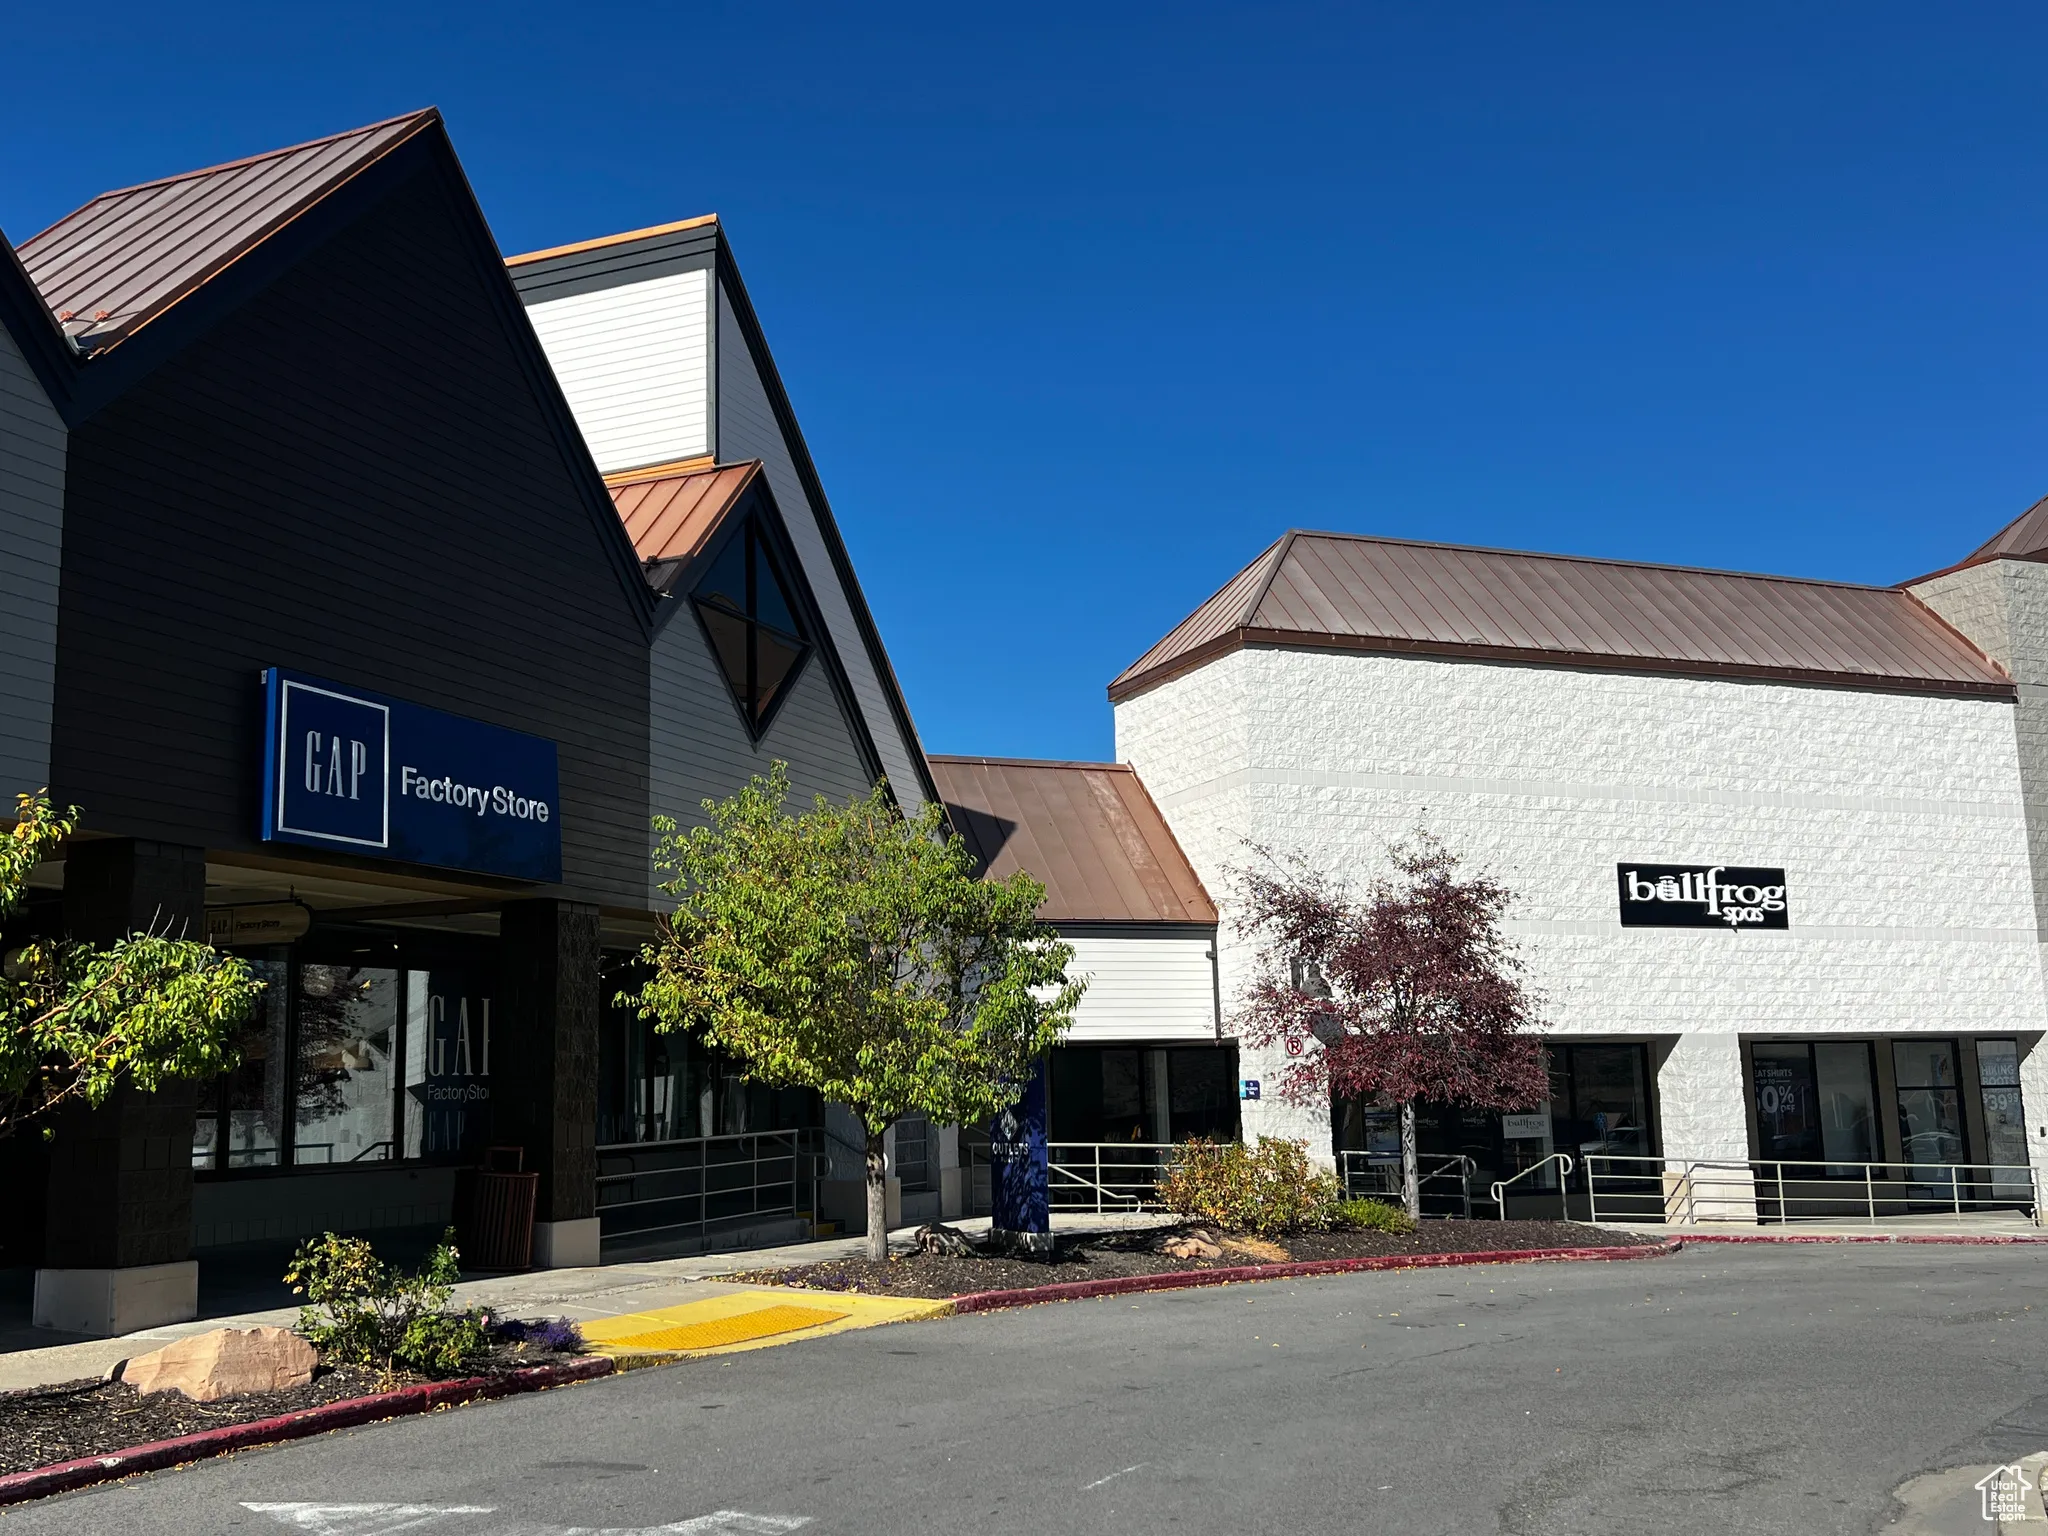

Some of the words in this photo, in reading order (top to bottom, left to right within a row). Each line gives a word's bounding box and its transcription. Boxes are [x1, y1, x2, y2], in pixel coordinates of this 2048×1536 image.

[305, 730, 366, 800] GAP
[402, 766, 489, 816] Factory
[492, 786, 549, 822] Store
[1625, 866, 1786, 915] bullfrog
[1722, 906, 1764, 926] spas
[1981, 1064, 2014, 1076] HIKING
[428, 1110, 467, 1152] GAP
[992, 1142, 1029, 1156] OUTLETS
